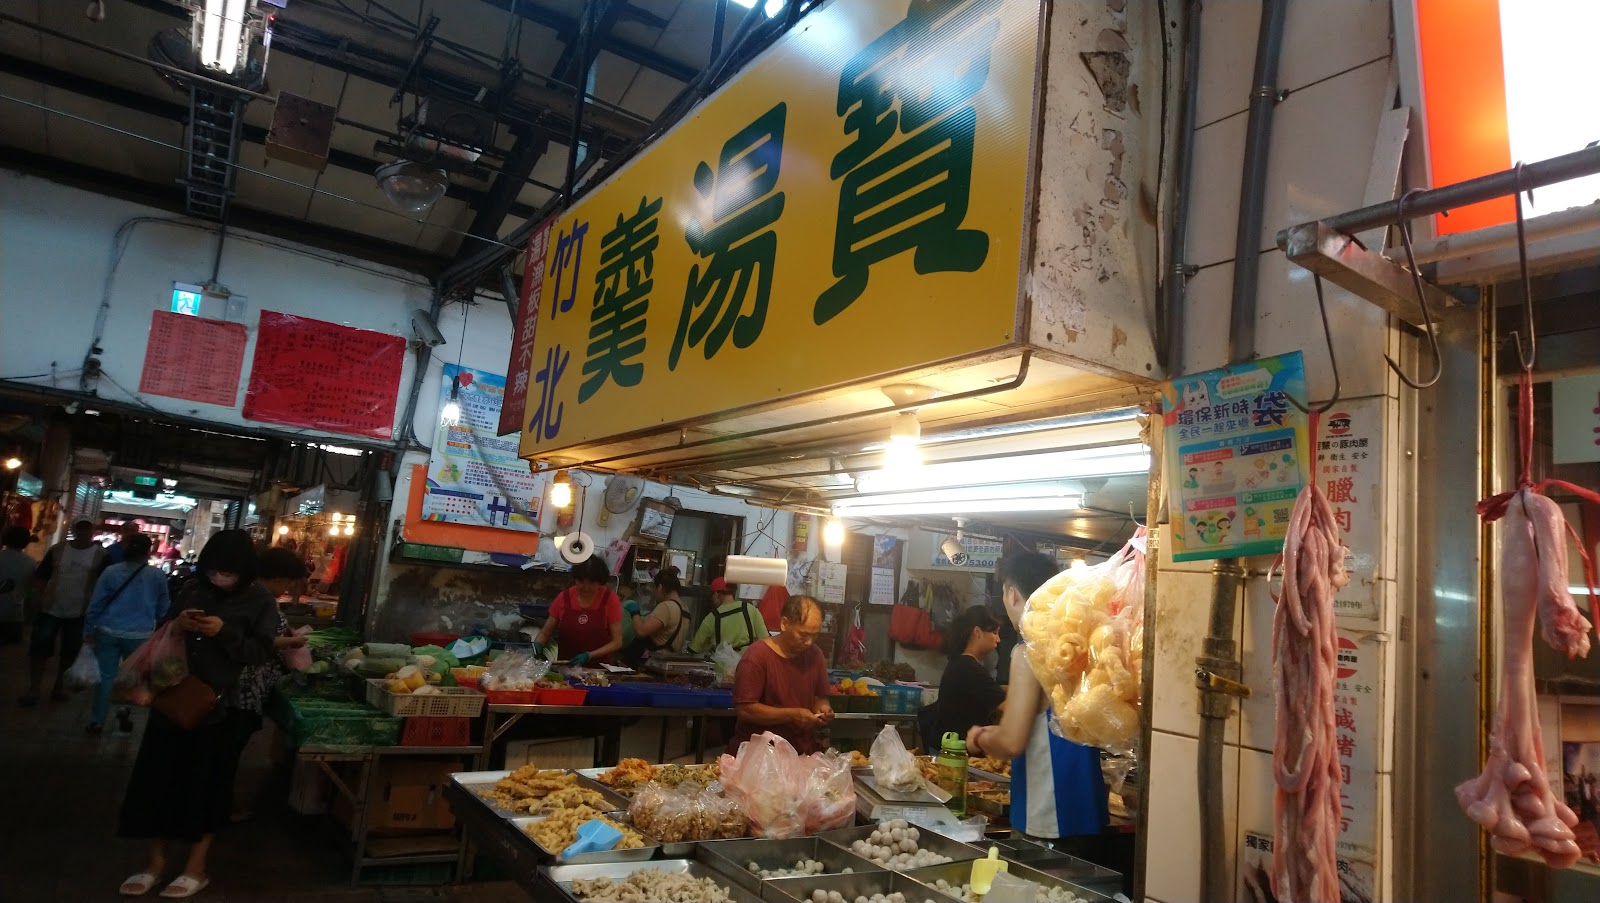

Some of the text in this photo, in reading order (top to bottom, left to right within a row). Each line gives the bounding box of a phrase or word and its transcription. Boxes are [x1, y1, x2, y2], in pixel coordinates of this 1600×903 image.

[529, 218, 589, 444] 竹北
[1177, 390, 1287, 427] 環保新時袋
[1351, 451, 1369, 460] 安全
[1354, 684, 1372, 693] 安全
[1246, 834, 1274, 854] 獨家
